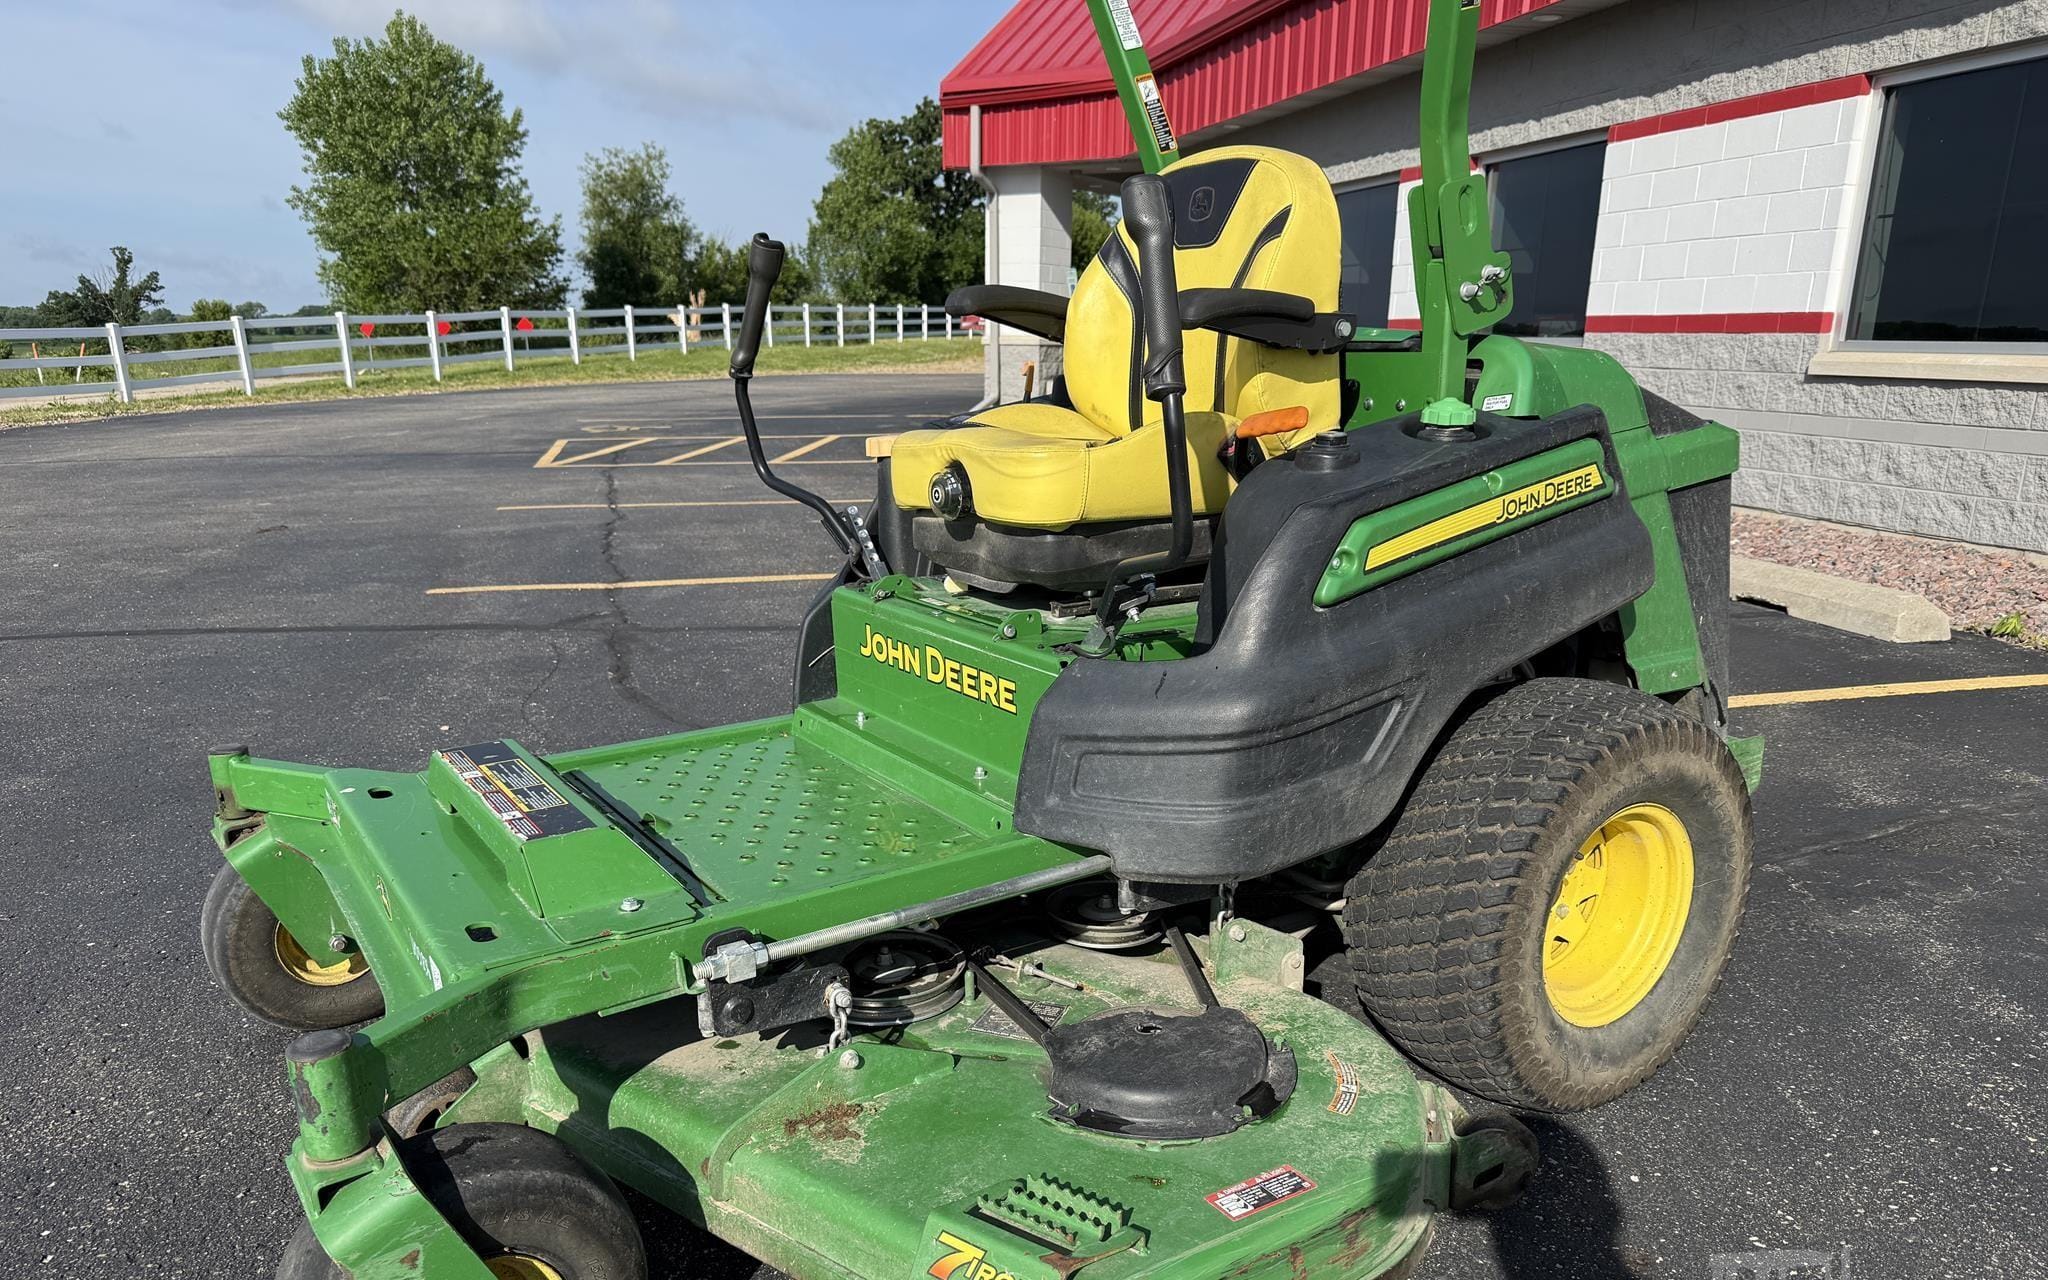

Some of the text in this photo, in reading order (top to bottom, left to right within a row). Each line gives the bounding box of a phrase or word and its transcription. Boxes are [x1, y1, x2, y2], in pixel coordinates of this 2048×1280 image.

[1496, 471, 1594, 523] JOHN DEERE
[860, 623, 1018, 717] JOHN DEERE
